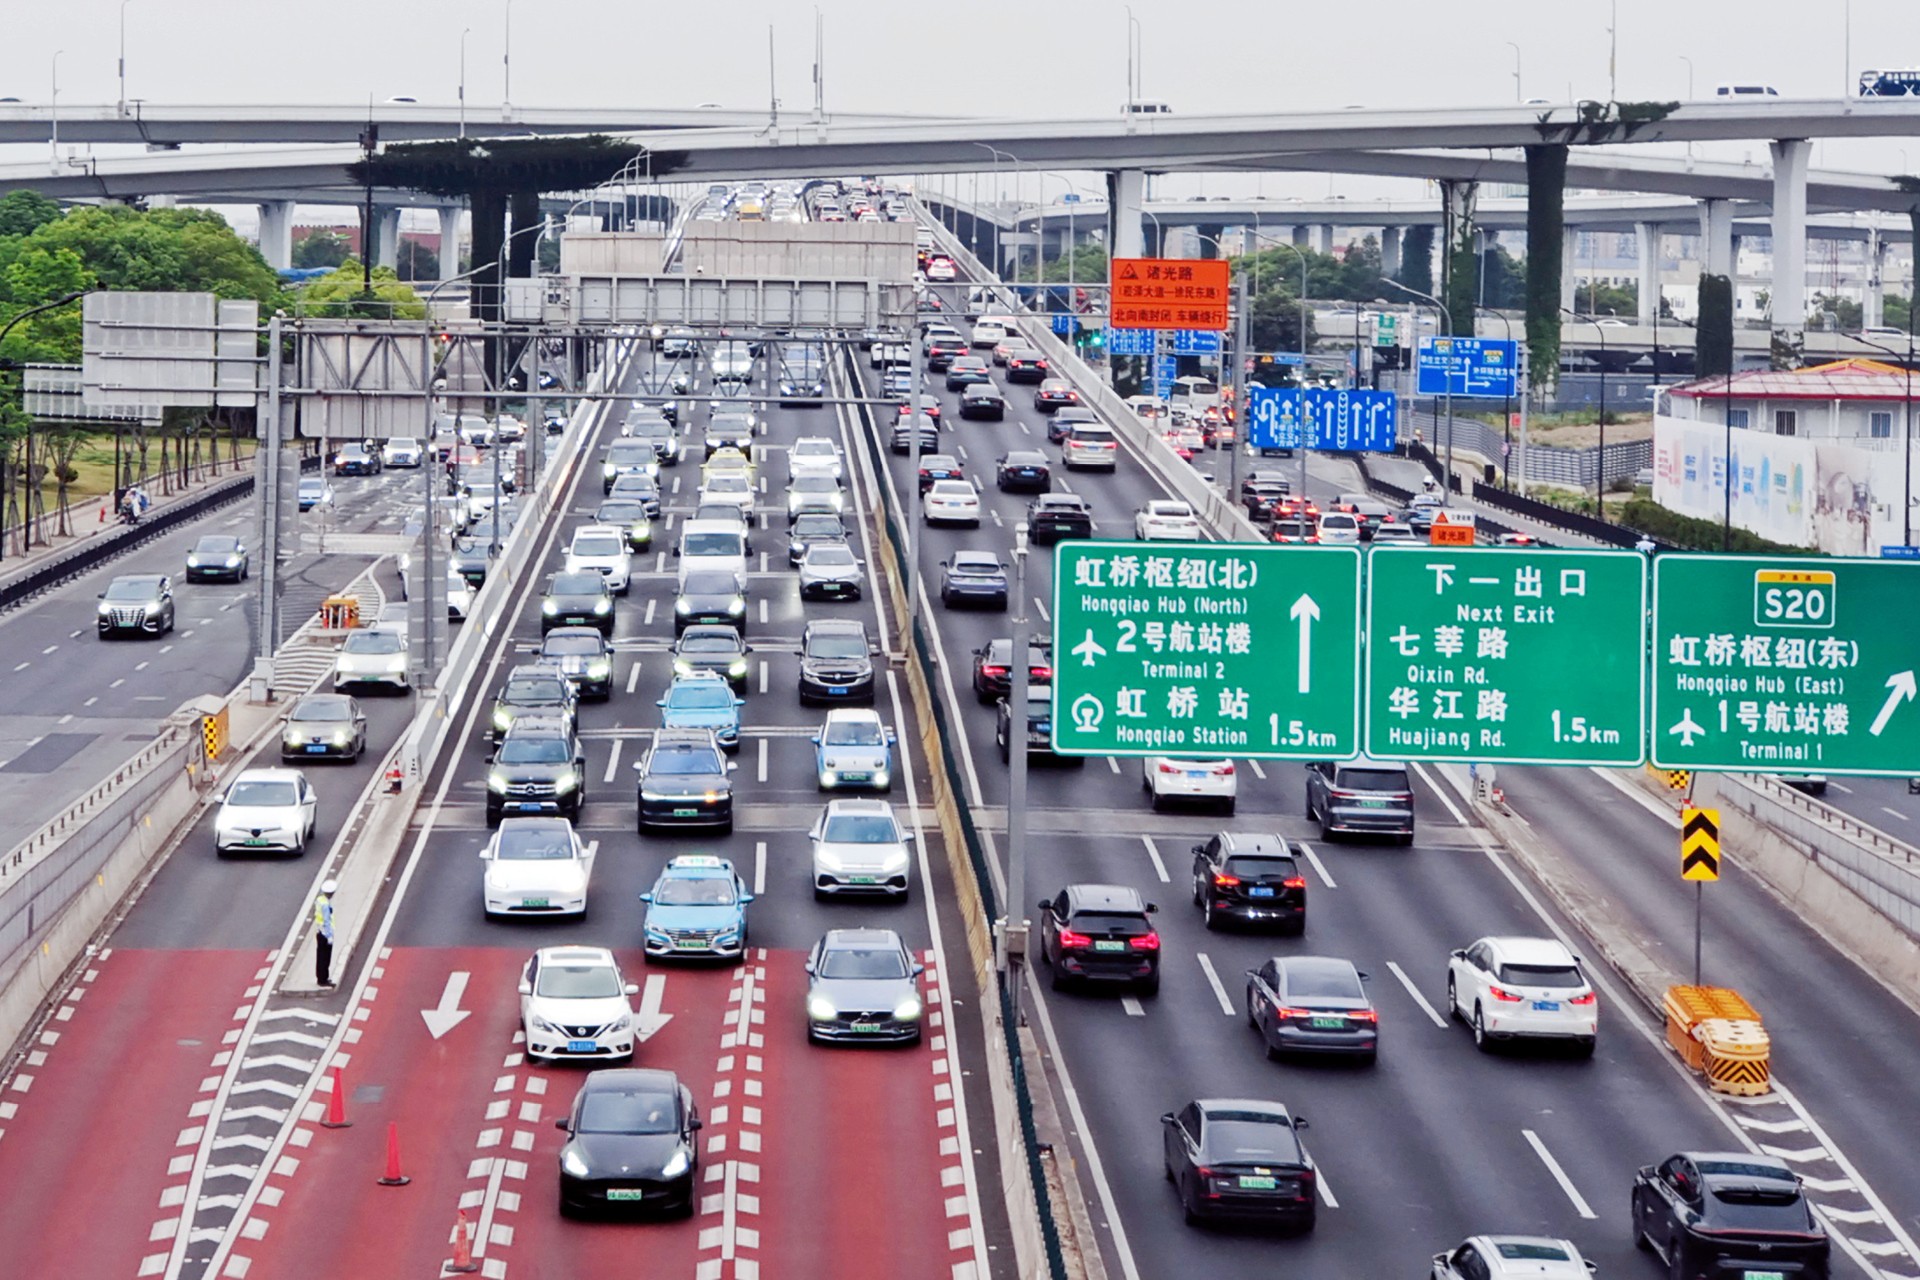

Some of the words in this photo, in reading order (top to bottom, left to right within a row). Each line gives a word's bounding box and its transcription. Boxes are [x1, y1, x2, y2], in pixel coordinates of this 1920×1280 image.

[1176, 310, 1223, 324] 车辆绕行
[1075, 555, 1257, 589] 虹桥枢纽(北)
[1426, 564, 1585, 598] 下一出口
[1082, 595, 1149, 617] Hongqiao
[1158, 596, 1186, 613] Hub
[1194, 597, 1247, 614] (North)
[1457, 604, 1502, 622] Next
[1514, 605, 1554, 623] Exit
[1765, 588, 1825, 619] S20
[1116, 619, 1251, 654] 2号航站楼
[1389, 625, 1509, 659] 七莘路
[1669, 633, 1859, 669] 虹桥枢纽(东)
[1142, 660, 1207, 678] Terminal
[1215, 661, 1224, 679] 2
[1407, 665, 1454, 683] Qixin
[1464, 666, 1489, 684] Rd.
[1677, 674, 1747, 696] Hongqiao
[1756, 676, 1785, 693] Hub
[1796, 676, 1843, 694] (East)
[1116, 685, 1249, 720] 虹桥站
[1389, 687, 1508, 722] 华江路
[1718, 699, 1849, 735] 1号航站楼
[1117, 726, 1185, 747] Hongqiao
[1193, 726, 1247, 744] Station
[1389, 728, 1470, 751] Huajiang
[1480, 729, 1505, 747] Rd.
[1741, 740, 1808, 759] Terminal
[1816, 743, 1823, 760] 1
